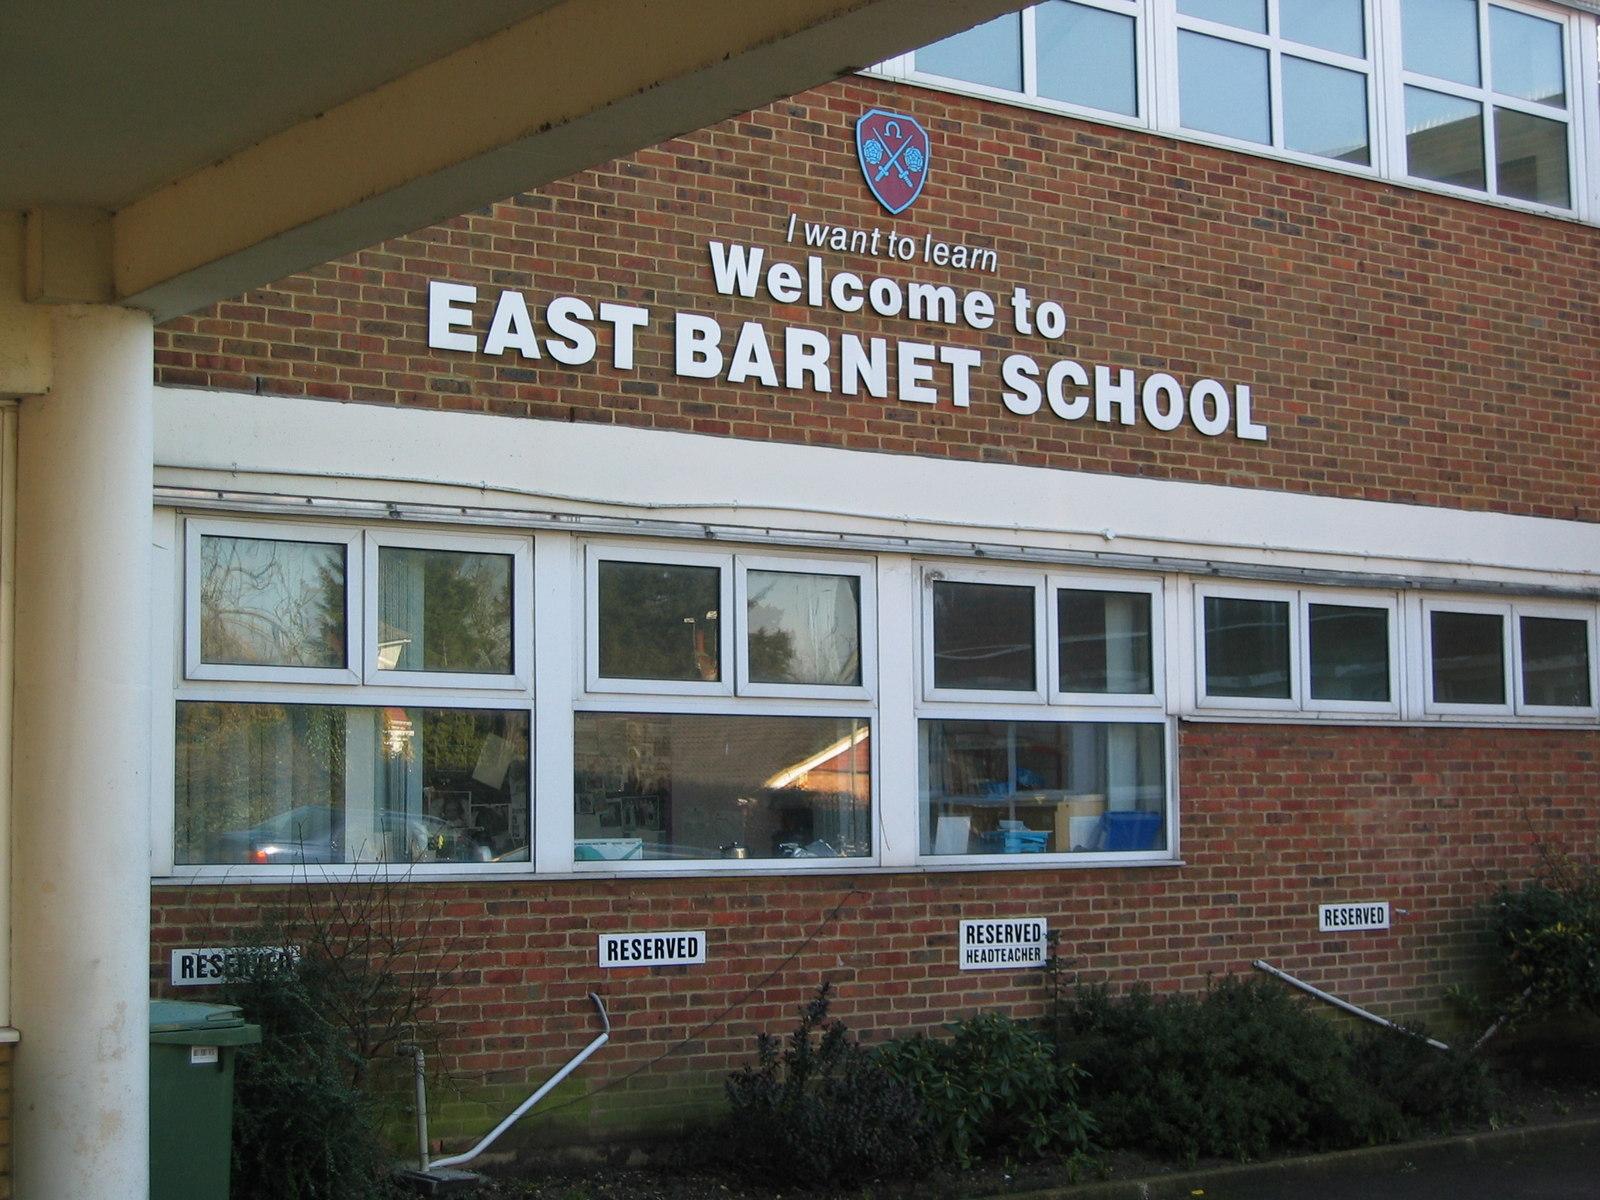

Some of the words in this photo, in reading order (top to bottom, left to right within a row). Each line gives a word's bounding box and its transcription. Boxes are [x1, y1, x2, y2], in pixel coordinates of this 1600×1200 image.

[787, 213, 796, 243] I
[804, 222, 881, 255] want
[888, 231, 915, 260] to
[924, 233, 997, 272] learn
[709, 241, 995, 329] Welcome
[1011, 288, 1067, 339] to
[428, 281, 649, 370] EAST
[675, 312, 981, 407] BARNET
[1001, 354, 1268, 441] SCHOOL
[1324, 906, 1384, 926] RESERVED
[966, 923, 1041, 944] RESERVED
[607, 937, 698, 961] RESERVED
[966, 947, 1041, 963] HEADTEACHER
[181, 952, 290, 979] RESE
